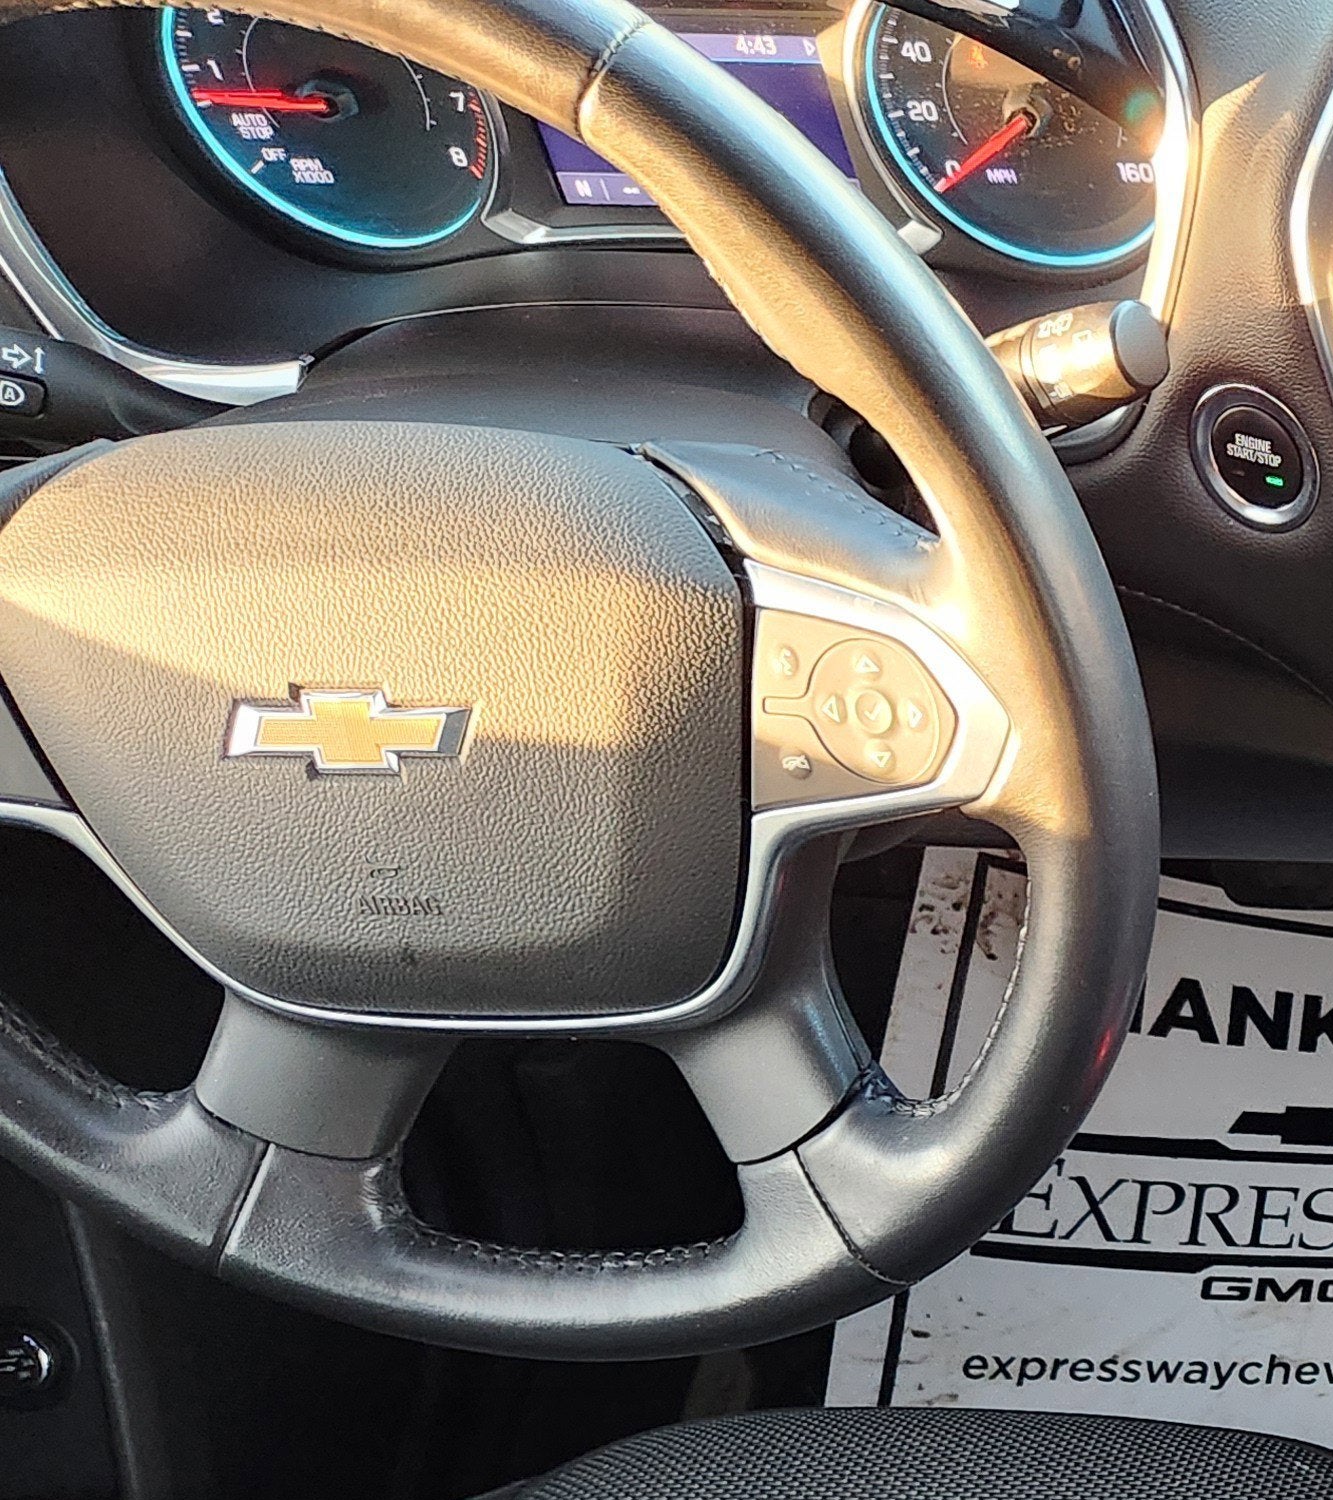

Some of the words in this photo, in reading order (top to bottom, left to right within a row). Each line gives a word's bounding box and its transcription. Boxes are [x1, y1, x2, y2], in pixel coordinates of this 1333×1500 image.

[736, 35, 777, 56] 4:43
[900, 41, 932, 63] 40
[206, 58, 223, 81] 1
[449, 91, 465, 112] 7
[907, 100, 939, 122] 20
[231, 112, 269, 128] AUTO
[240, 125, 273, 140] STOP
[261, 147, 287, 162] OFF
[290, 157, 324, 172] RPM
[449, 146, 468, 168] 8
[985, 168, 1018, 185] MPH
[1116, 161, 1155, 183] 160
[574, 179, 593, 198] N
[1234, 432, 1272, 454] ENGINE
[1226, 442, 1282, 468] START/STOP
